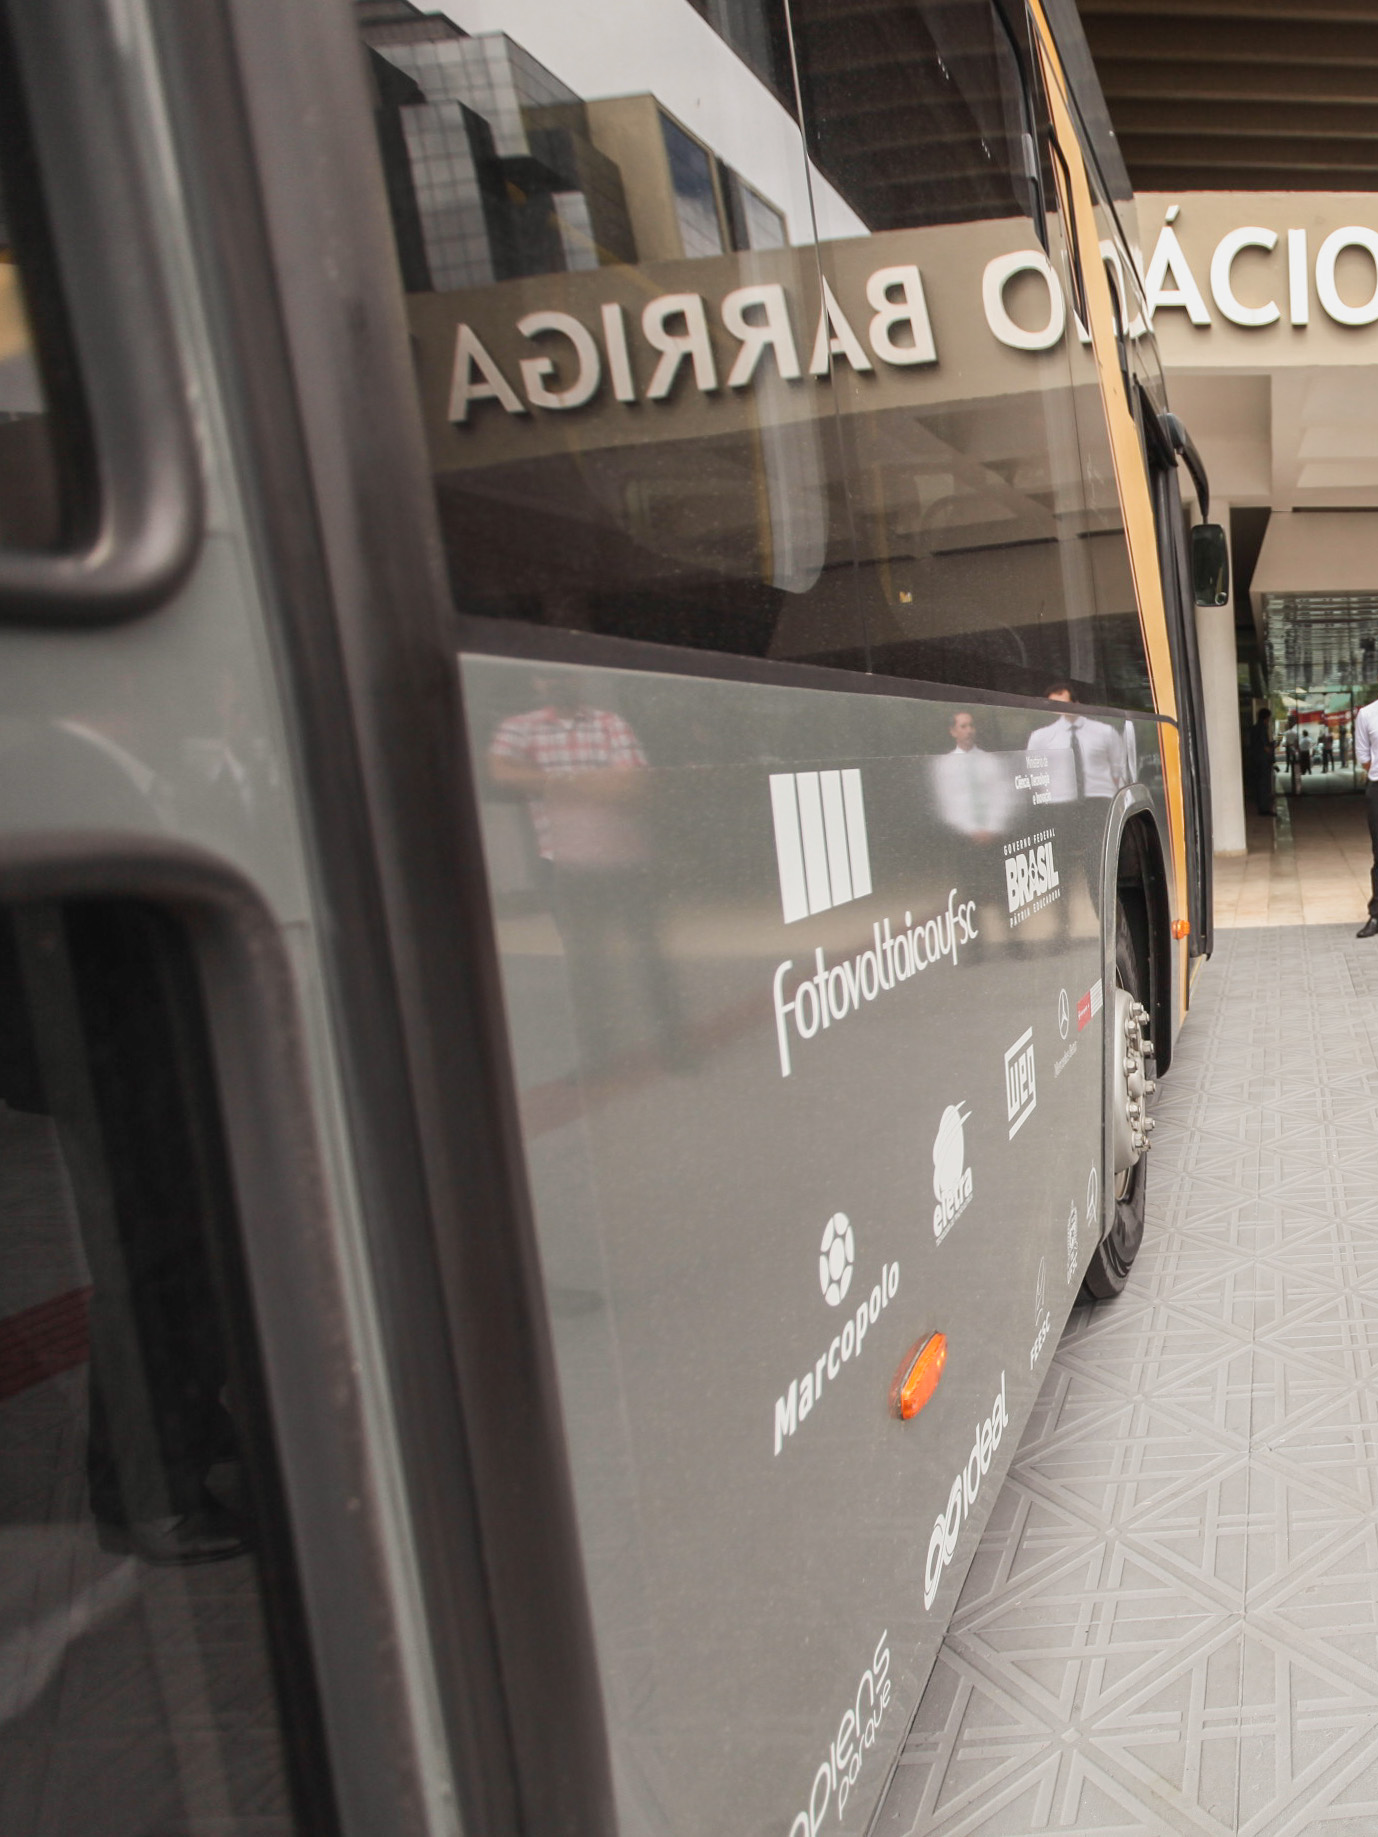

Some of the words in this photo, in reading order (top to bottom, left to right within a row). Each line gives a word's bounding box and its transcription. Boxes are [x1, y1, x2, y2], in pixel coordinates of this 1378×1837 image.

[1003, 836, 1031, 856] GOVERNO
[1033, 828, 1056, 845] FEDERAL
[1005, 842, 1060, 913] BRASIL
[774, 1261, 899, 1457] Marcopolo
[838, 1679, 891, 1821] parque
